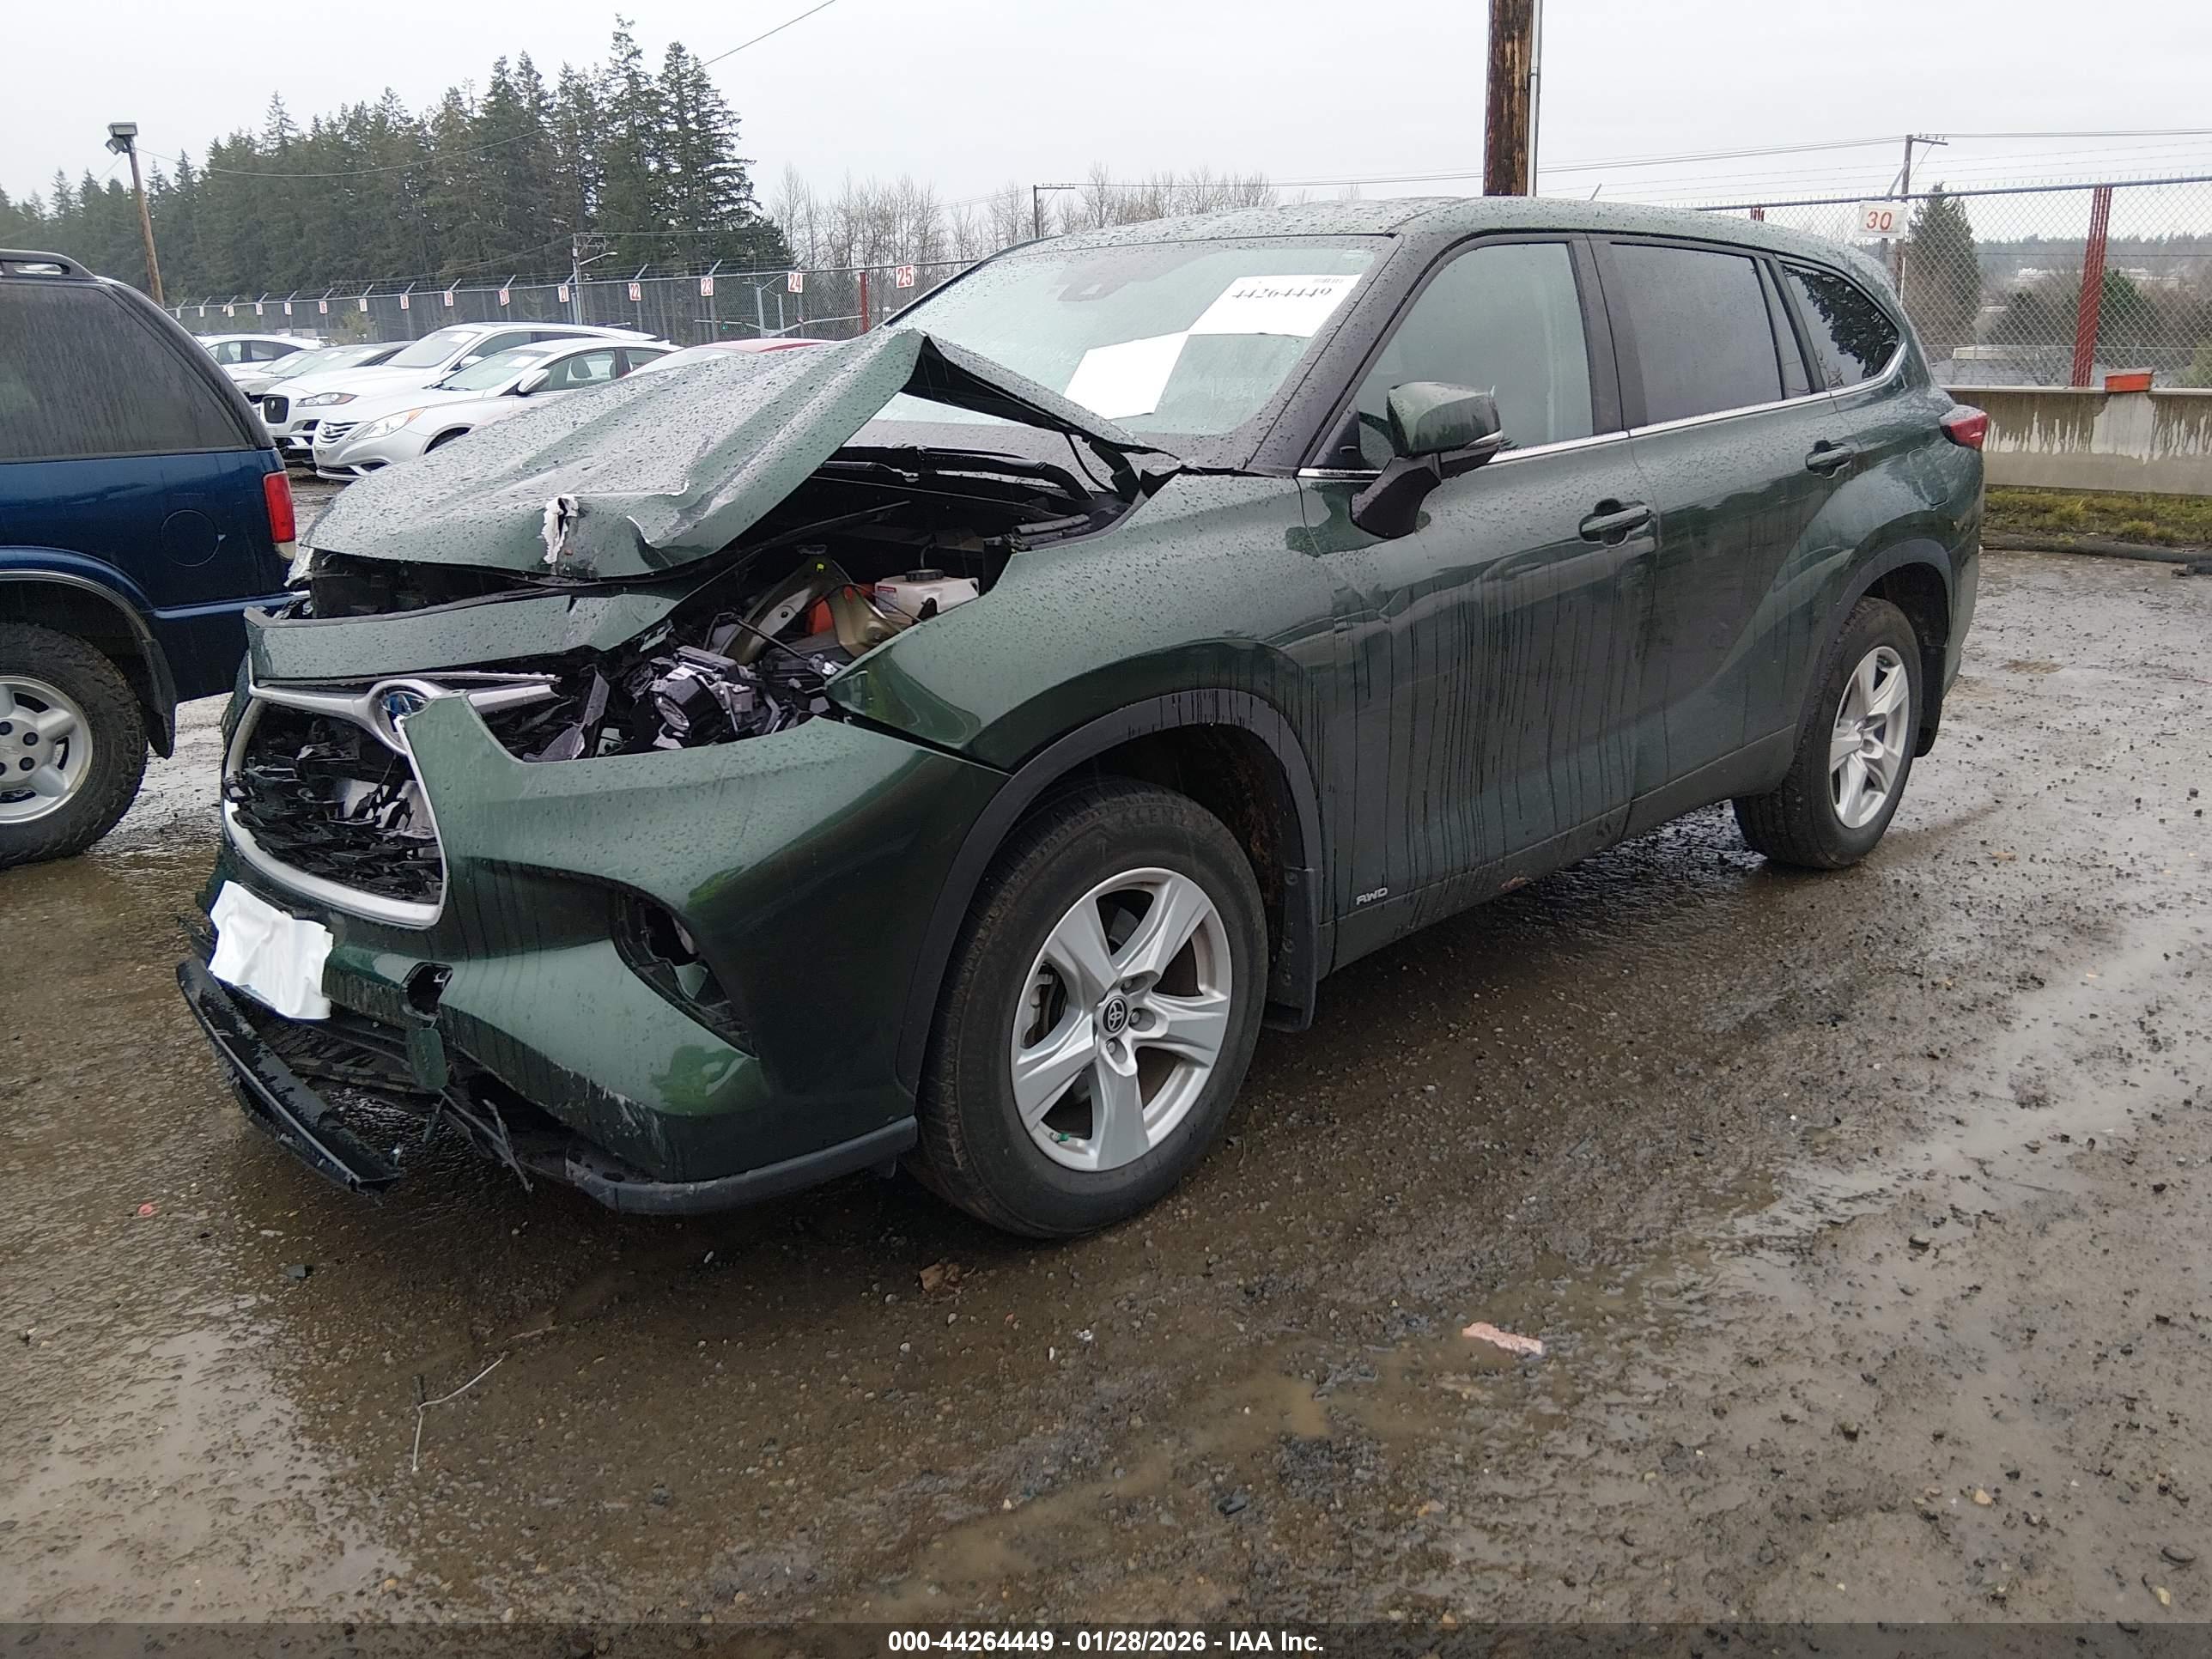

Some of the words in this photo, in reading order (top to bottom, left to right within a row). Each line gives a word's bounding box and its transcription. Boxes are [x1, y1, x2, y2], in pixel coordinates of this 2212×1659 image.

[1866, 210, 1893, 231] 30
[789, 273, 801, 292] 24
[897, 266, 913, 287] 25
[560, 287, 568, 302] 21
[629, 284, 641, 300] 22
[702, 278, 713, 295] 23
[1356, 887, 1389, 906] AWD
